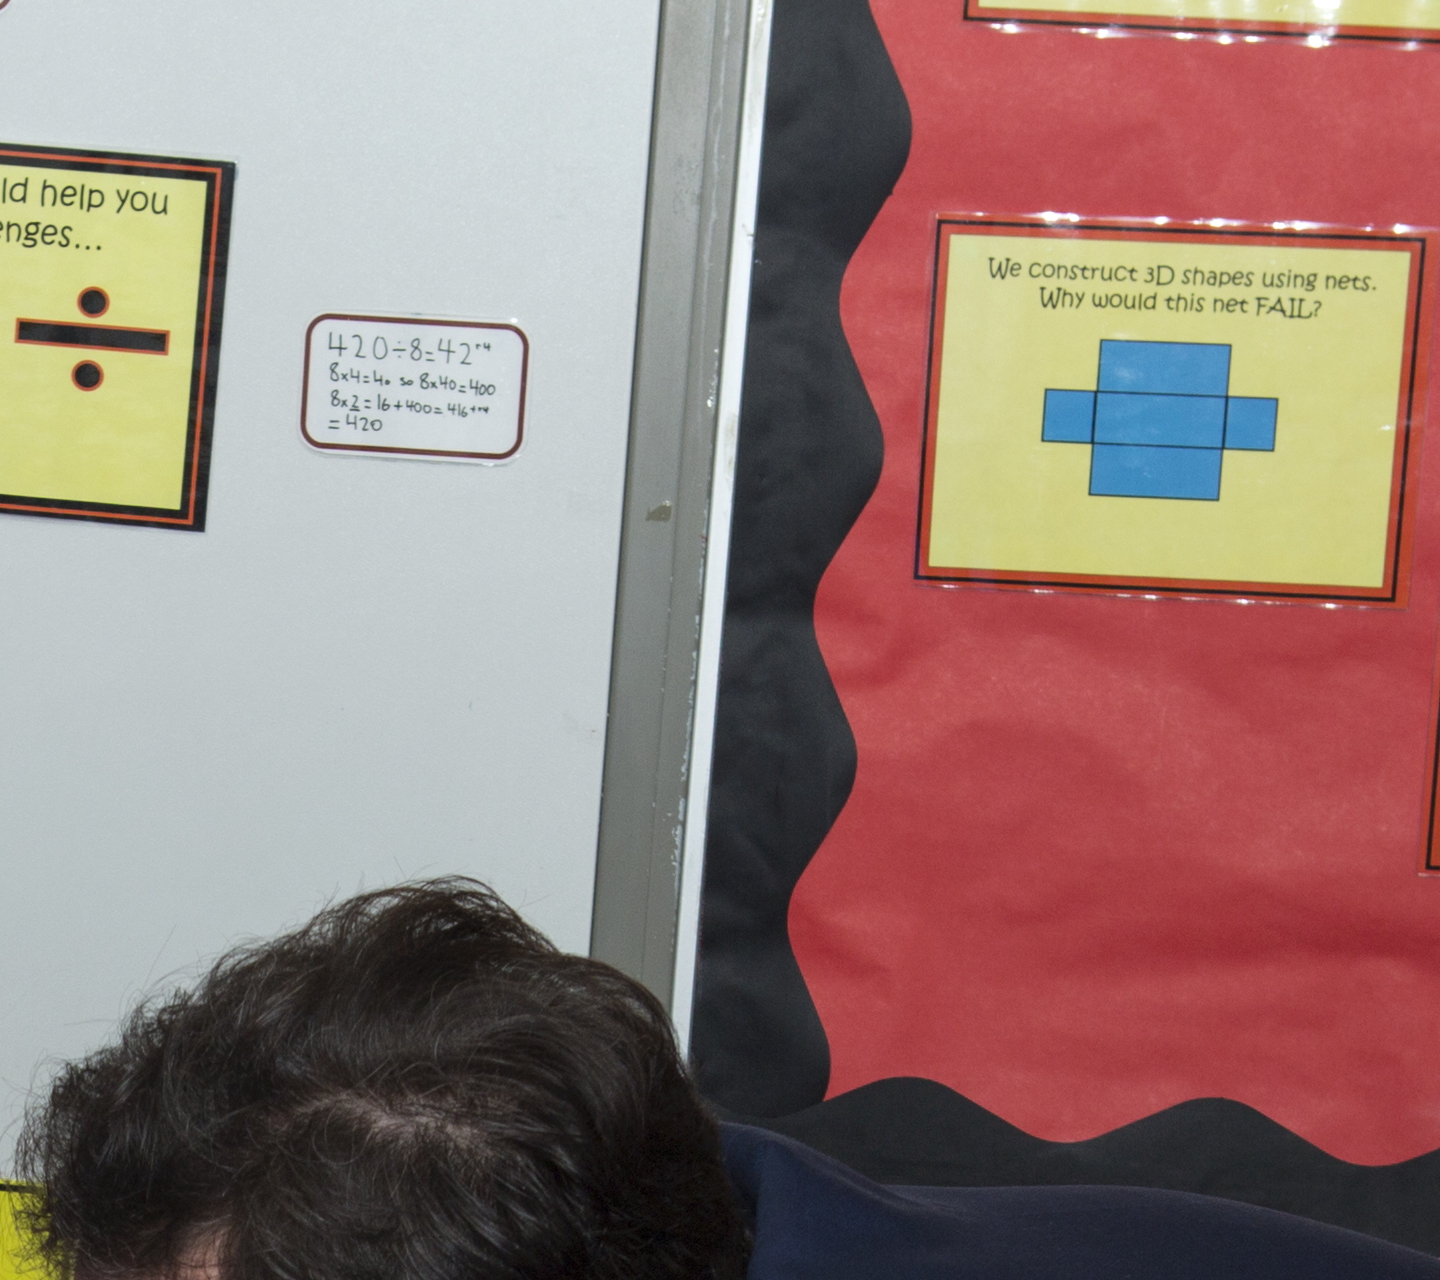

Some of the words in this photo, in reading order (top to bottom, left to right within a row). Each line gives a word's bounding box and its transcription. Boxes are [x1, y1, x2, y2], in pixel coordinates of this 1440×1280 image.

[40, 179, 105, 213] help
[116, 189, 168, 215] you
[988, 256, 1022, 281] We
[1028, 262, 1138, 282] construct
[1143, 264, 1175, 287] 3D
[1181, 267, 1255, 288] shapes
[1262, 269, 1318, 292] using
[1325, 274, 1377, 292] nets.
[1039, 286, 1085, 310] Why
[1091, 292, 1158, 311] would
[1164, 293, 1206, 313] this
[1213, 297, 1249, 314] net
[1255, 296, 1322, 320] FAIL?
